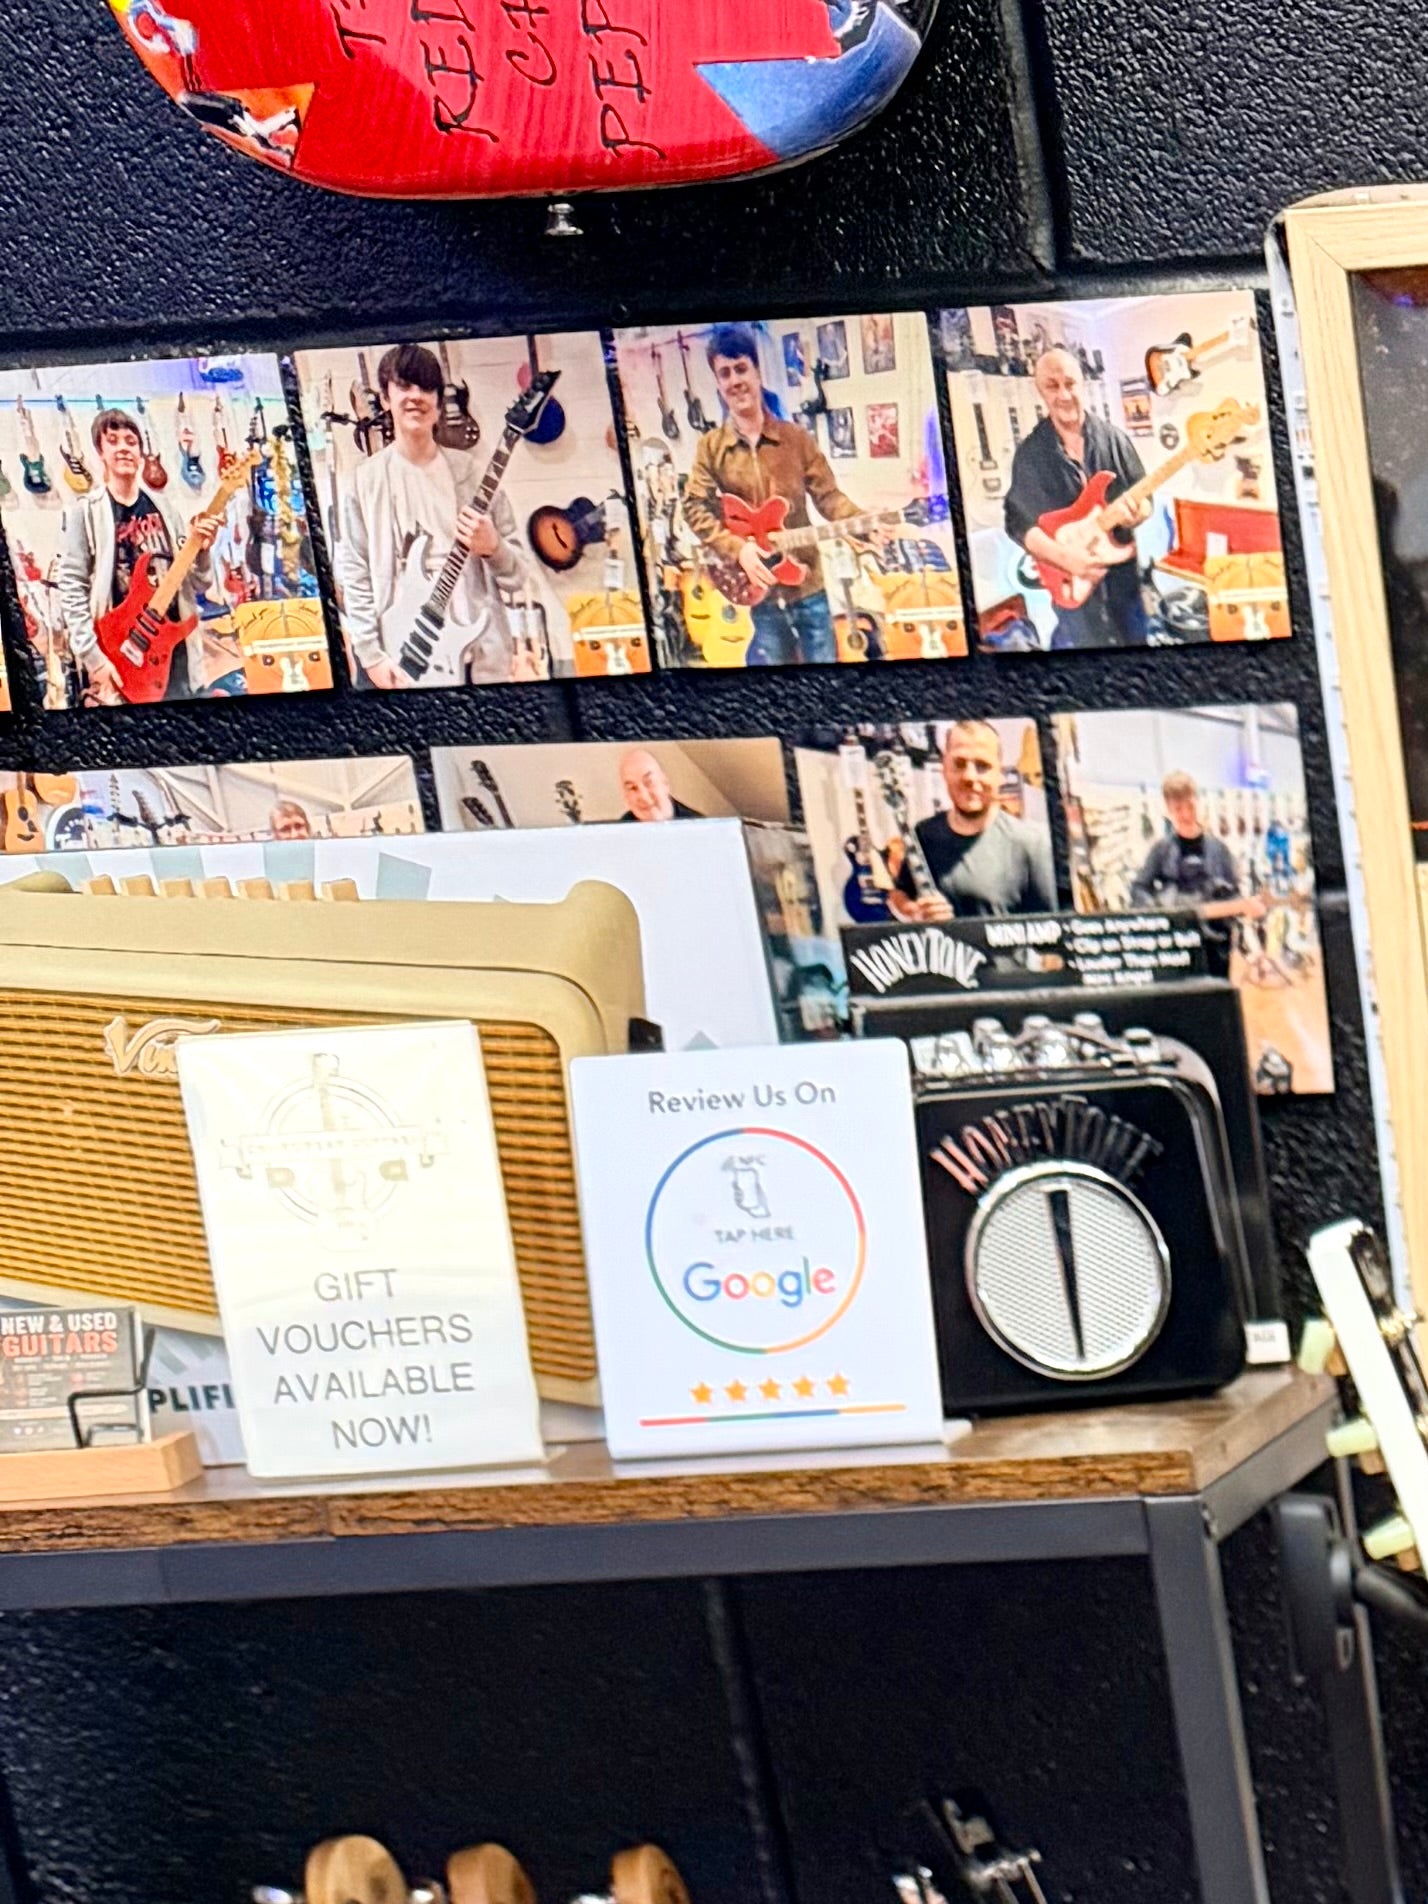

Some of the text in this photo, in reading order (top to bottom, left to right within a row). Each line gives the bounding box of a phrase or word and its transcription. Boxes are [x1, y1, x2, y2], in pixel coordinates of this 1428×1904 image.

[648, 1081, 837, 1114] Review Us On
[714, 1225, 794, 1243] TAP HERE
[314, 1268, 398, 1301] GIFT
[683, 1256, 836, 1308] Google
[0, 1312, 117, 1335] NEW & USED
[256, 1313, 473, 1355] VOUCHERS
[2, 1331, 118, 1357] GUITARS
[274, 1362, 475, 1404] AVAILABLE
[331, 1414, 432, 1449] NOW!
